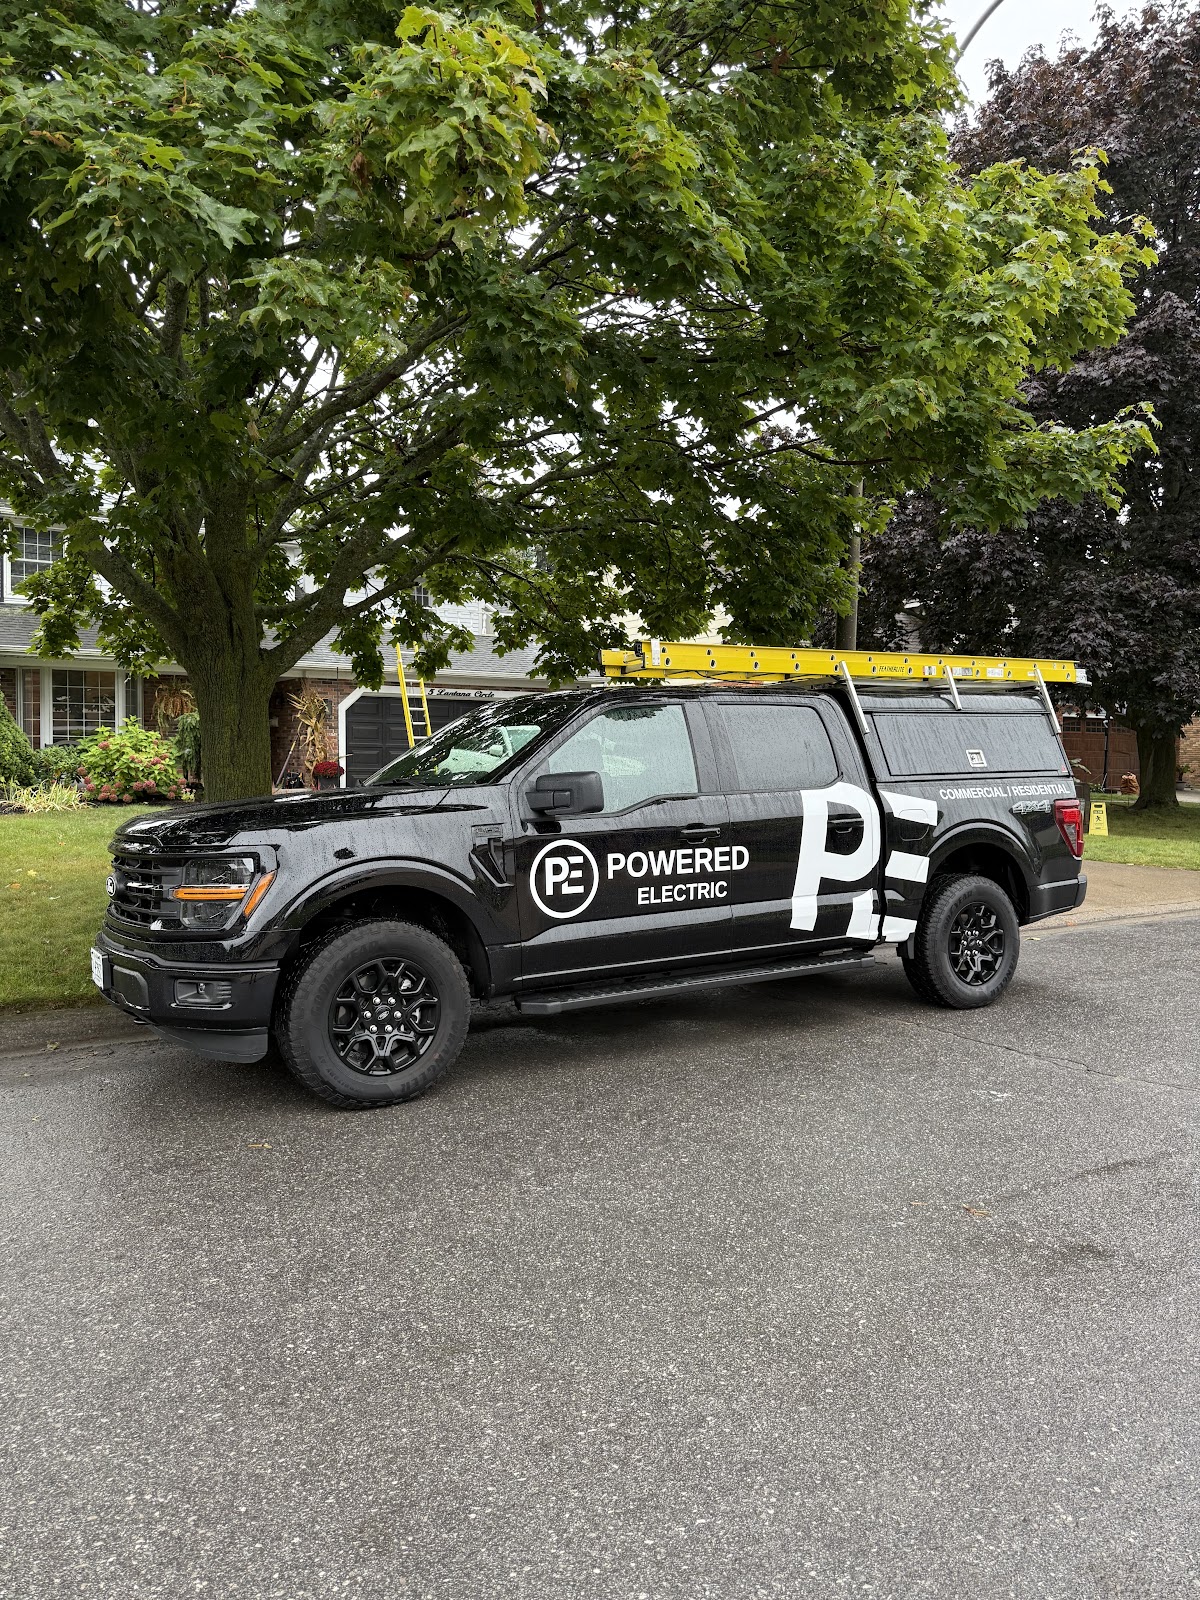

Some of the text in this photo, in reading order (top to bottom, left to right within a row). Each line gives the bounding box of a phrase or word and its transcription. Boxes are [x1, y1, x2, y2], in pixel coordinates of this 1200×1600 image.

[879, 665, 905, 673] FEATHERLITE
[437, 689, 471, 697] Lantana
[939, 784, 1008, 800] COMMERCIAL
[1011, 783, 1071, 797] RESIDENTIAL
[607, 845, 750, 880] POWERED
[790, 782, 938, 942] PE
[545, 855, 585, 896] PE
[637, 880, 728, 905] ELECTRIC
